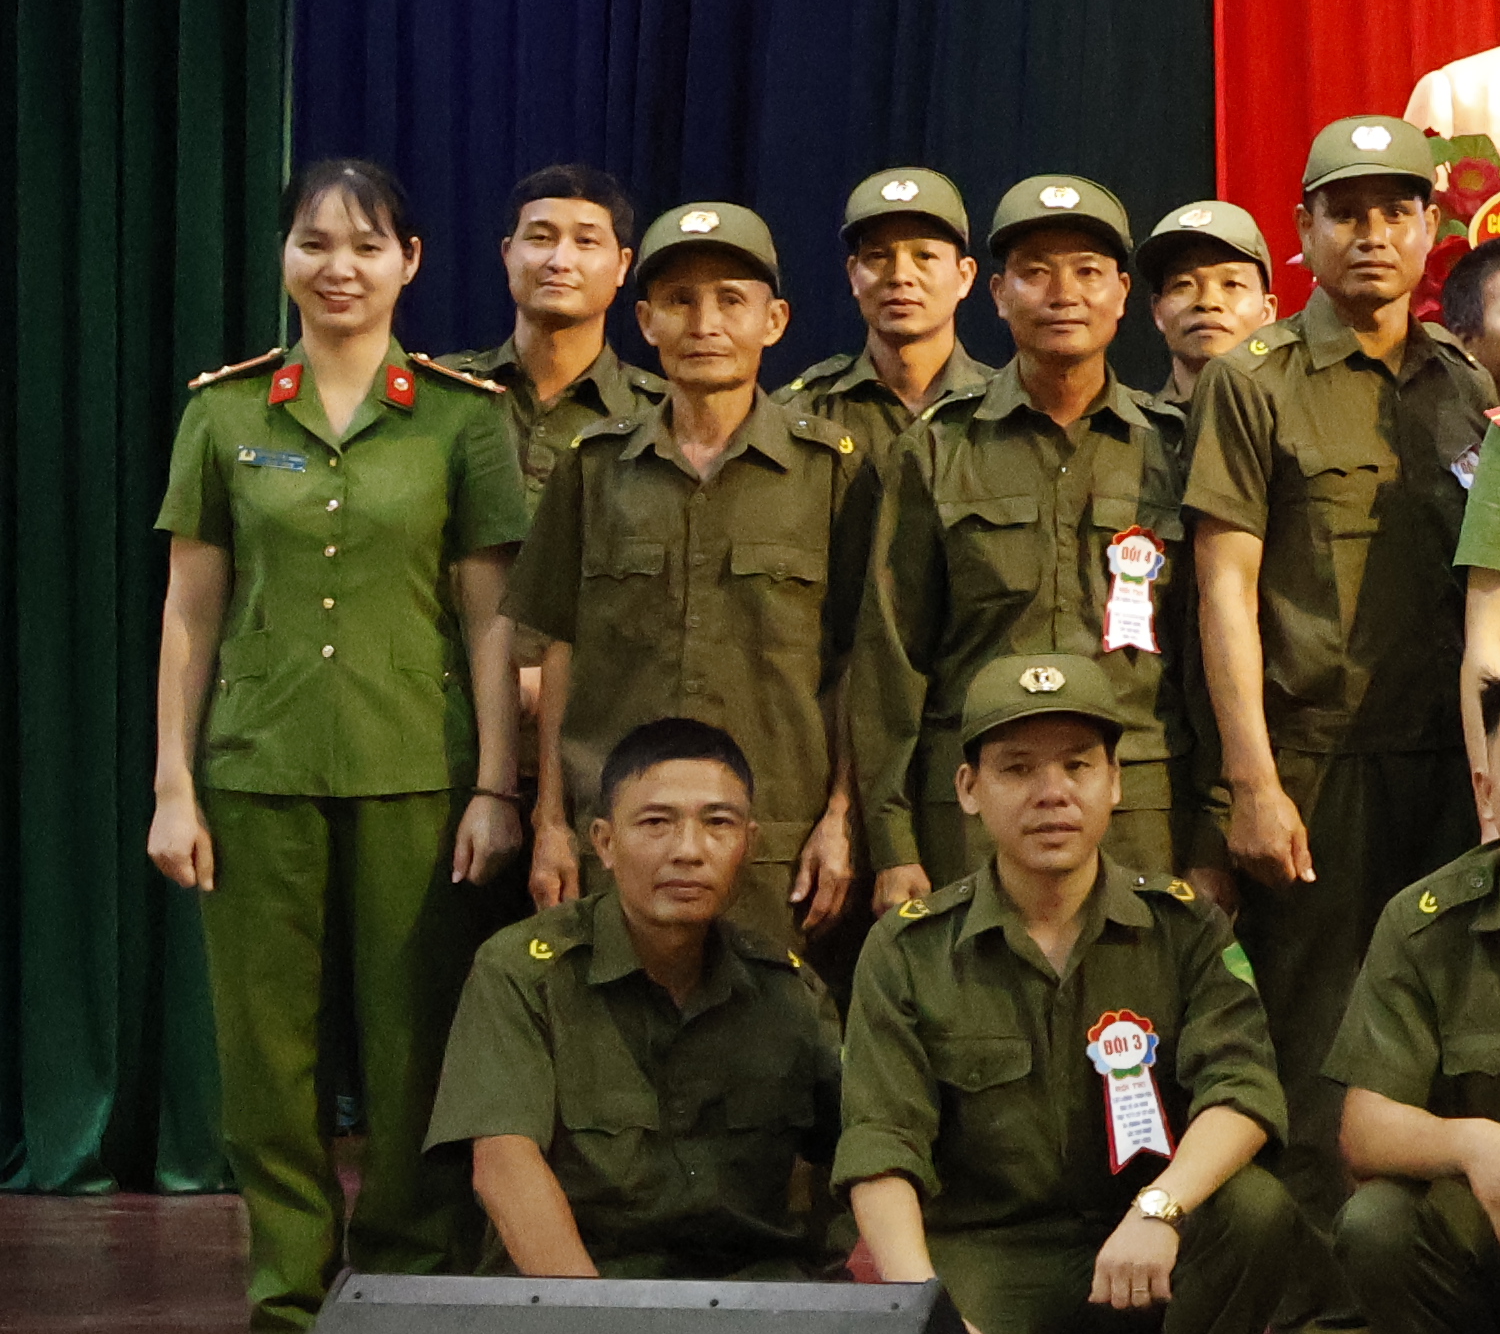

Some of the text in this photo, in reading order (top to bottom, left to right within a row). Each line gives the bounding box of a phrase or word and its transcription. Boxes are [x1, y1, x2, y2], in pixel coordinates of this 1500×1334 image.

[1144, 550, 1151, 564] 4
[1103, 1033, 1142, 1057] ĐỘI 3
